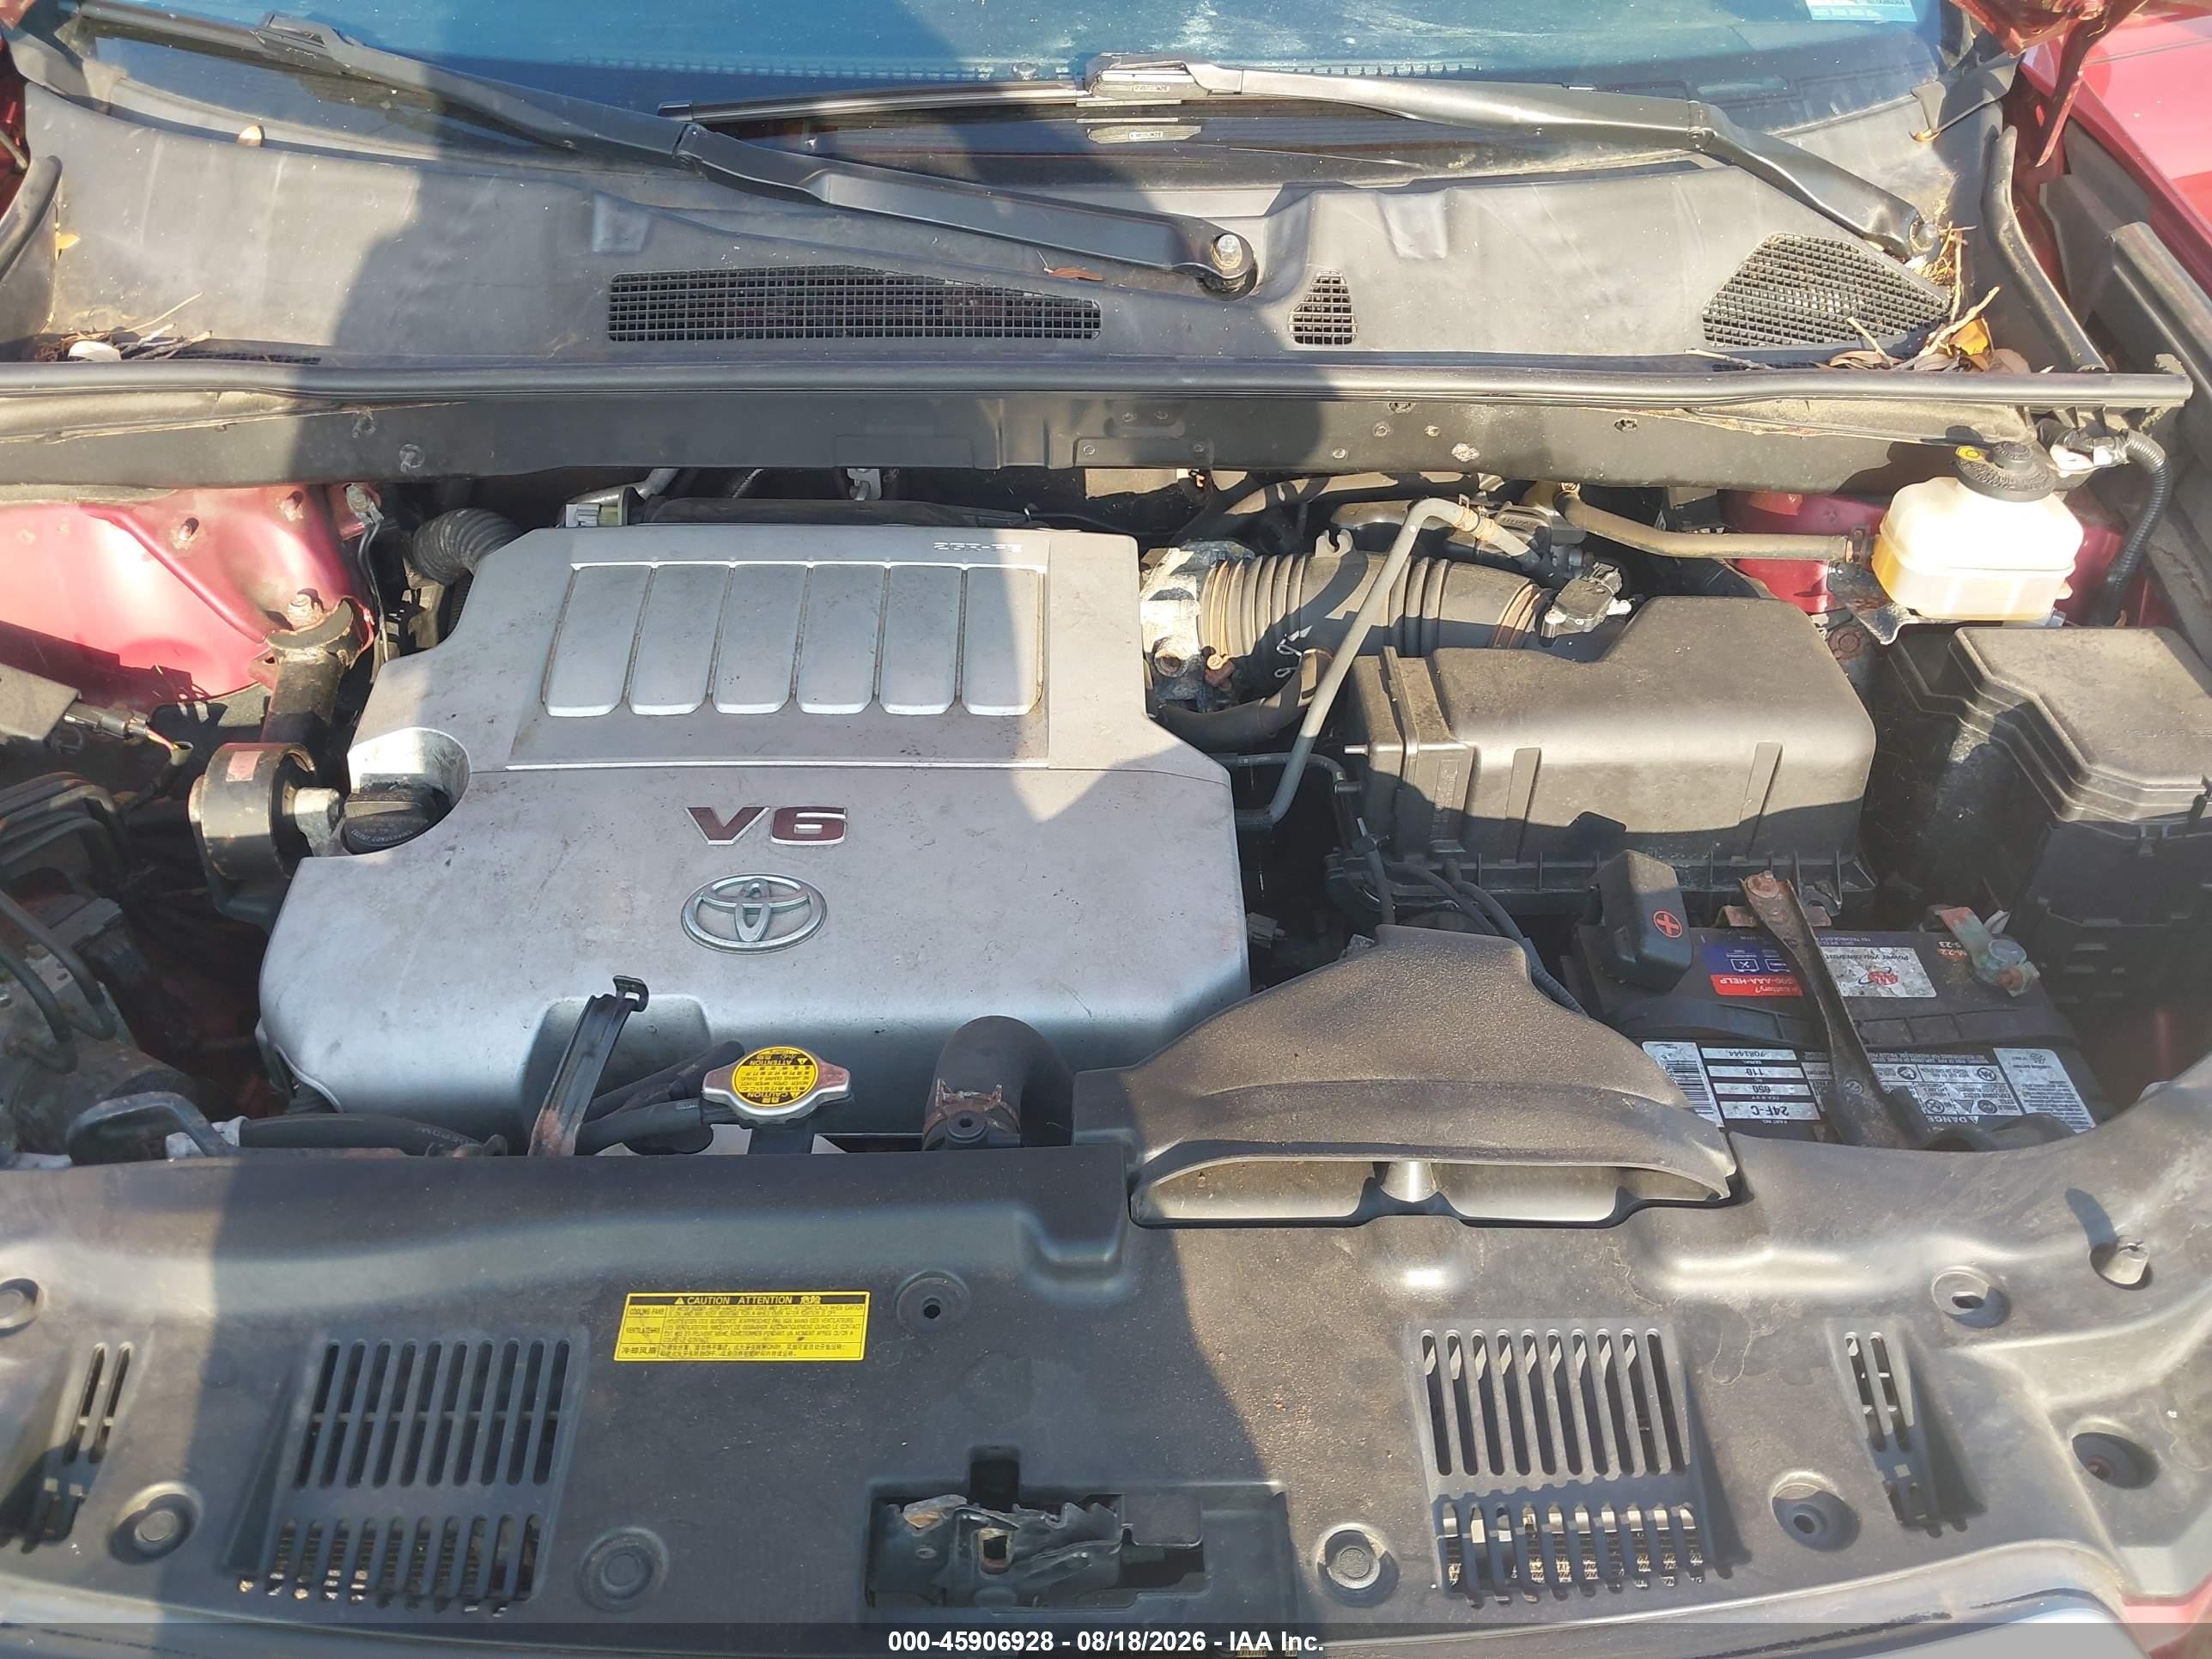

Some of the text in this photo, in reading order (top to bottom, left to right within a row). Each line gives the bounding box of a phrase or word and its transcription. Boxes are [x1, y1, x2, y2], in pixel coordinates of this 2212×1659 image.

[686, 806, 848, 846] V6
[1745, 1067, 1765, 1076] 110
[1752, 1085, 1771, 1093] 650
[1750, 1105, 1790, 1116] 24F-C
[687, 1296, 731, 1305] CAUTION
[738, 1296, 793, 1304] ATTENTION
